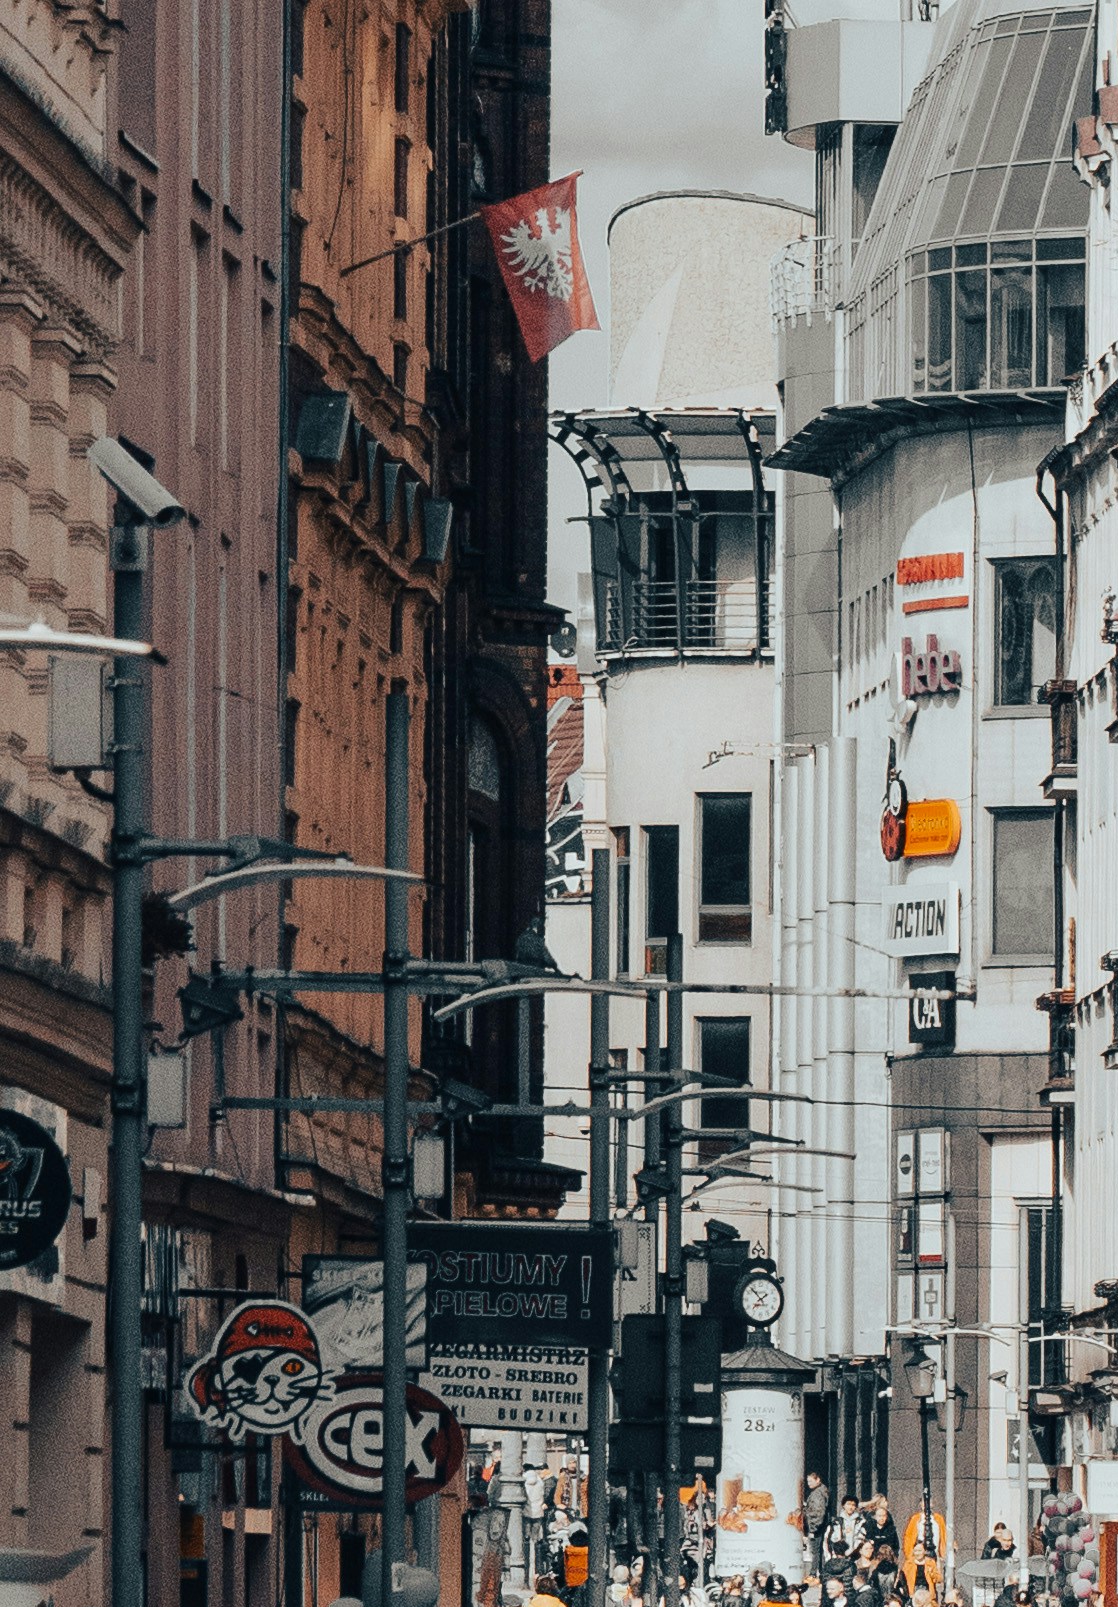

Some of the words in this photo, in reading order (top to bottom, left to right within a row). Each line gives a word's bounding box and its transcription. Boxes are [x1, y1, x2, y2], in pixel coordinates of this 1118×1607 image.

[894, 899, 945, 939] ACTION
[913, 986, 942, 1029] C&A
[407, 1250, 568, 1285] OSTIUMY
[431, 1290, 568, 1319] PIELOWE
[505, 1368, 578, 1386] SREBRO
[441, 1383, 522, 1402] ZEGARKI
[531, 1389, 584, 1405] BATERIE
[498, 1407, 578, 1425] BUDZIKI
[743, 1406, 776, 1415] ZESTAW
